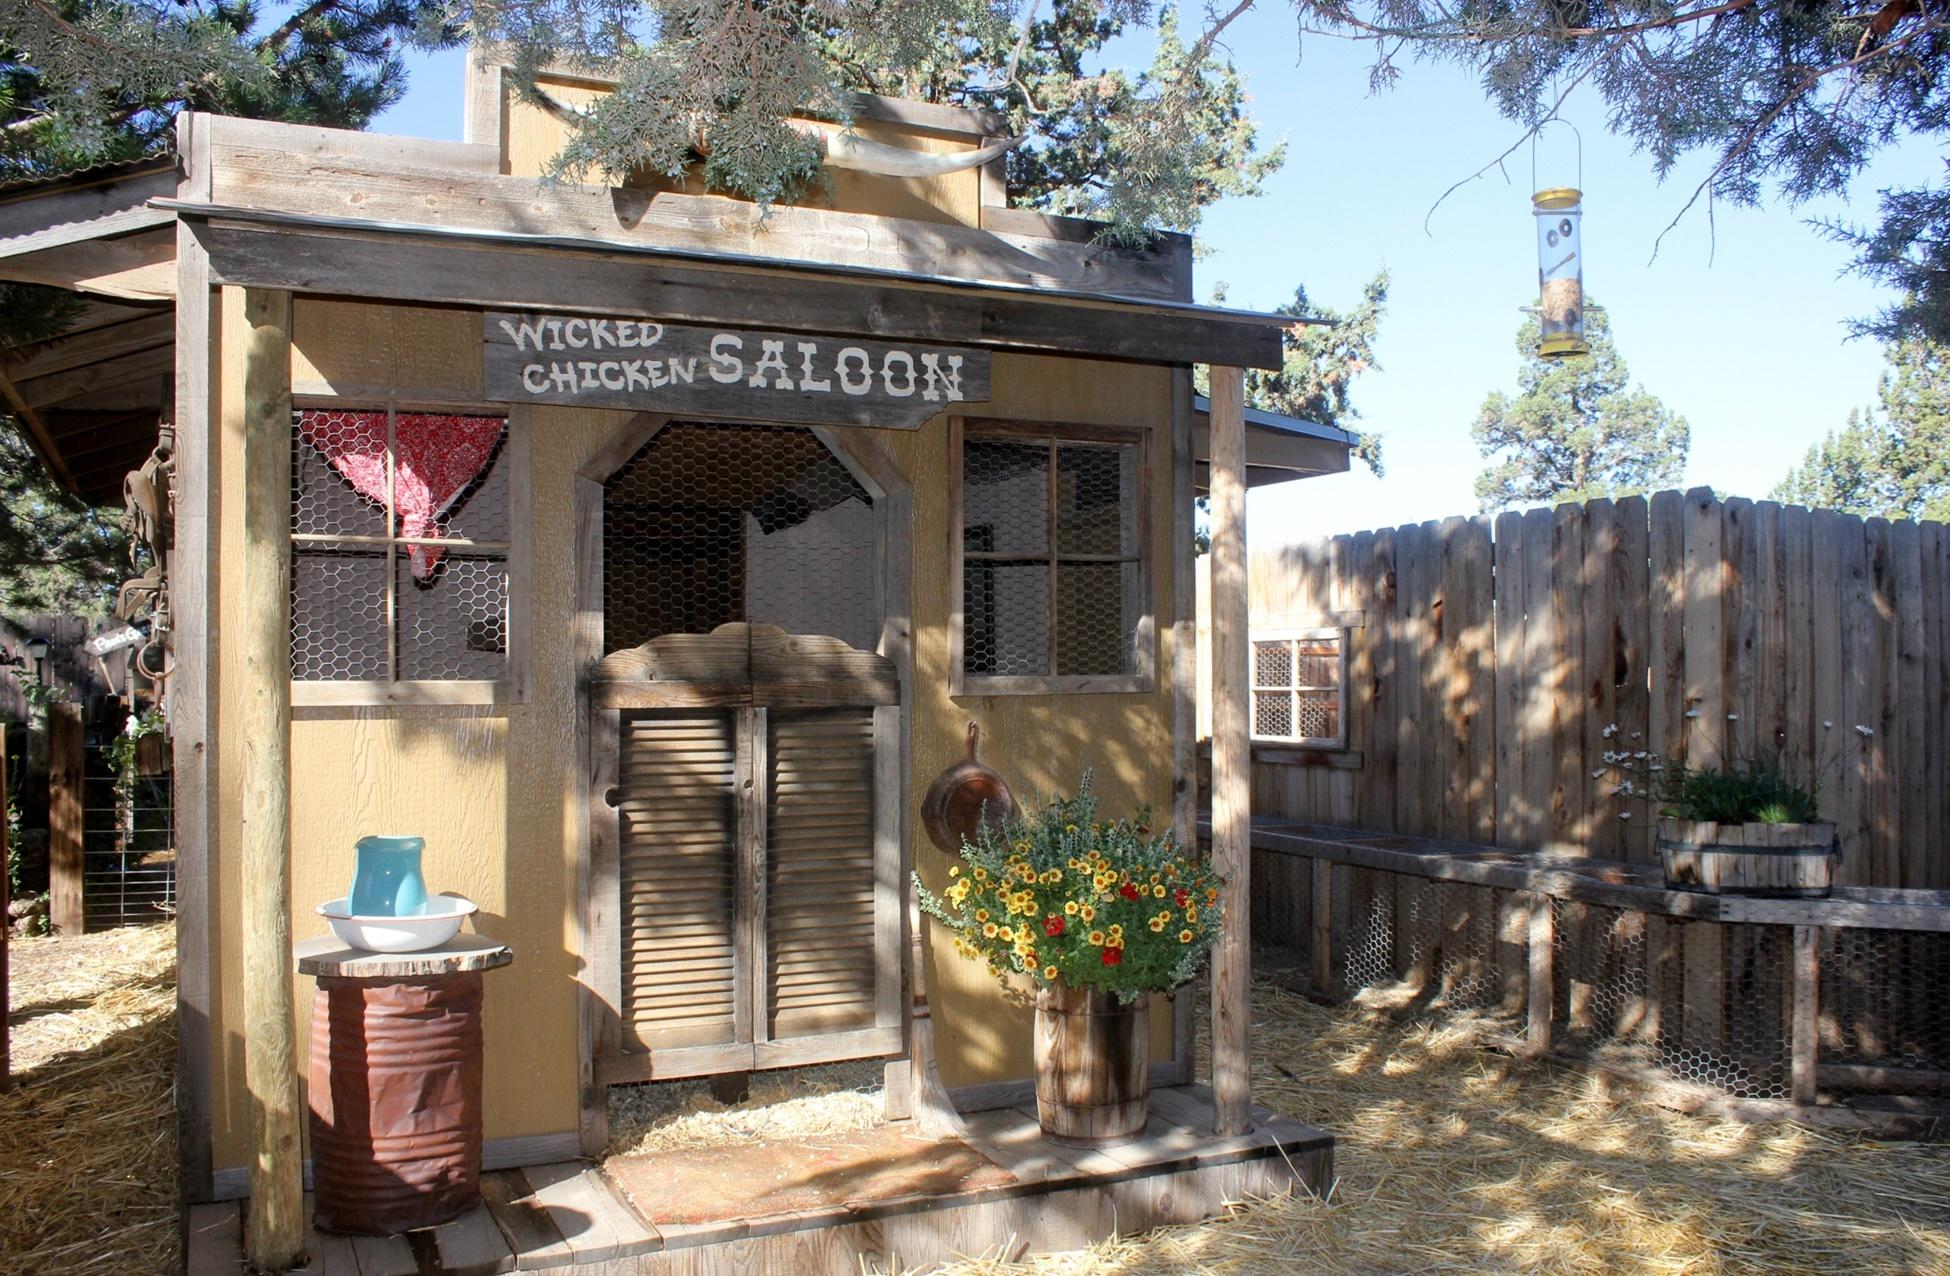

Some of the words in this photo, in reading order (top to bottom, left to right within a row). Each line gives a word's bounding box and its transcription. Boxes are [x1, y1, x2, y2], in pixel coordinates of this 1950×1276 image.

[499, 318, 663, 350] WICKED
[522, 357, 697, 394] CHICKEN
[708, 334, 964, 401] SALOON
